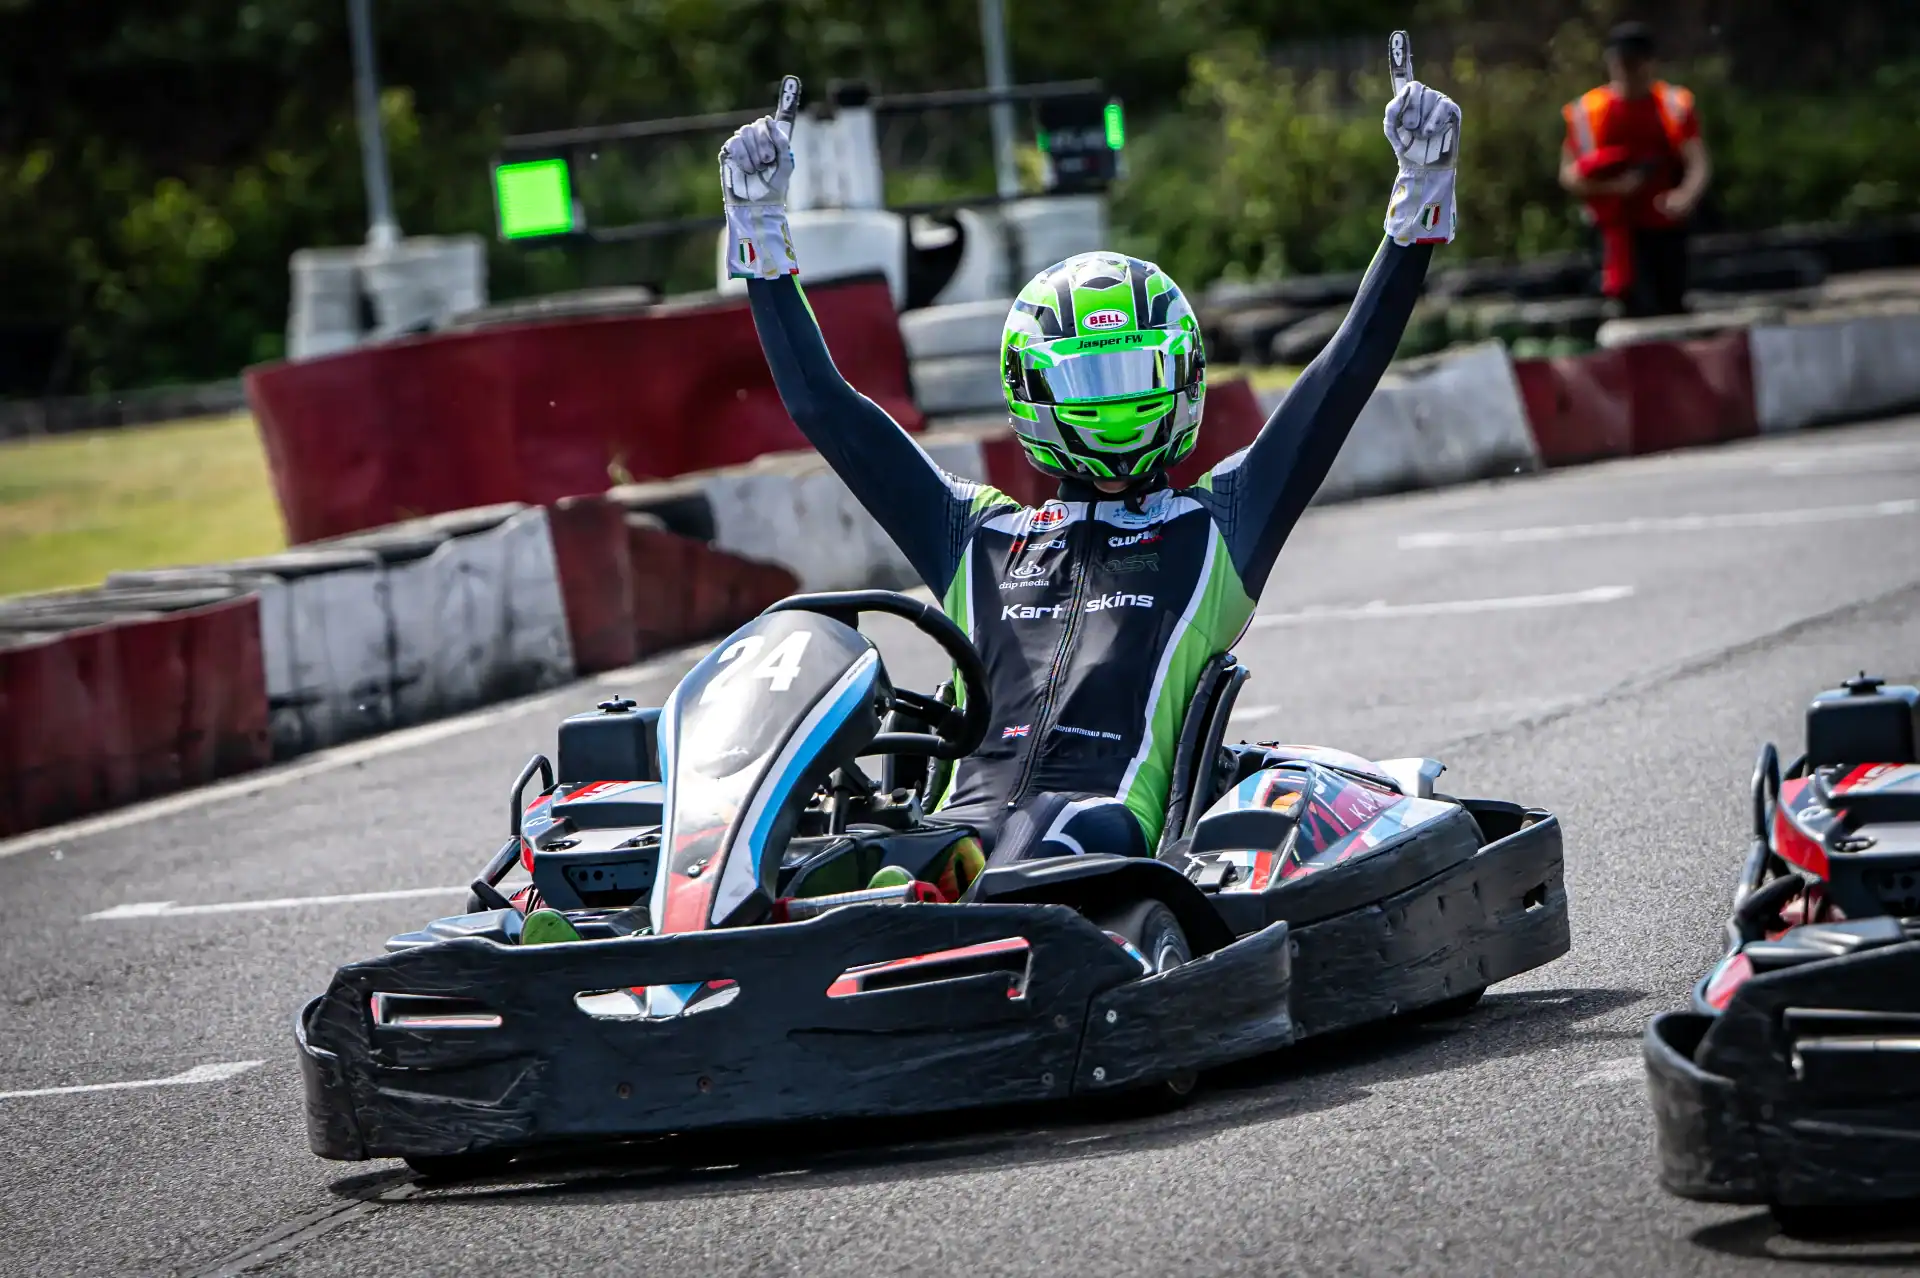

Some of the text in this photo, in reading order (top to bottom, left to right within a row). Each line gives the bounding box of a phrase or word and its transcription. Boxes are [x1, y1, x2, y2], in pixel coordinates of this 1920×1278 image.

[1089, 314, 1123, 325] BELL
[1076, 334, 1144, 350] Jasper FW
[999, 579, 1049, 590] drip media
[1001, 591, 1154, 620] Kart skins
[699, 630, 812, 706] 24
